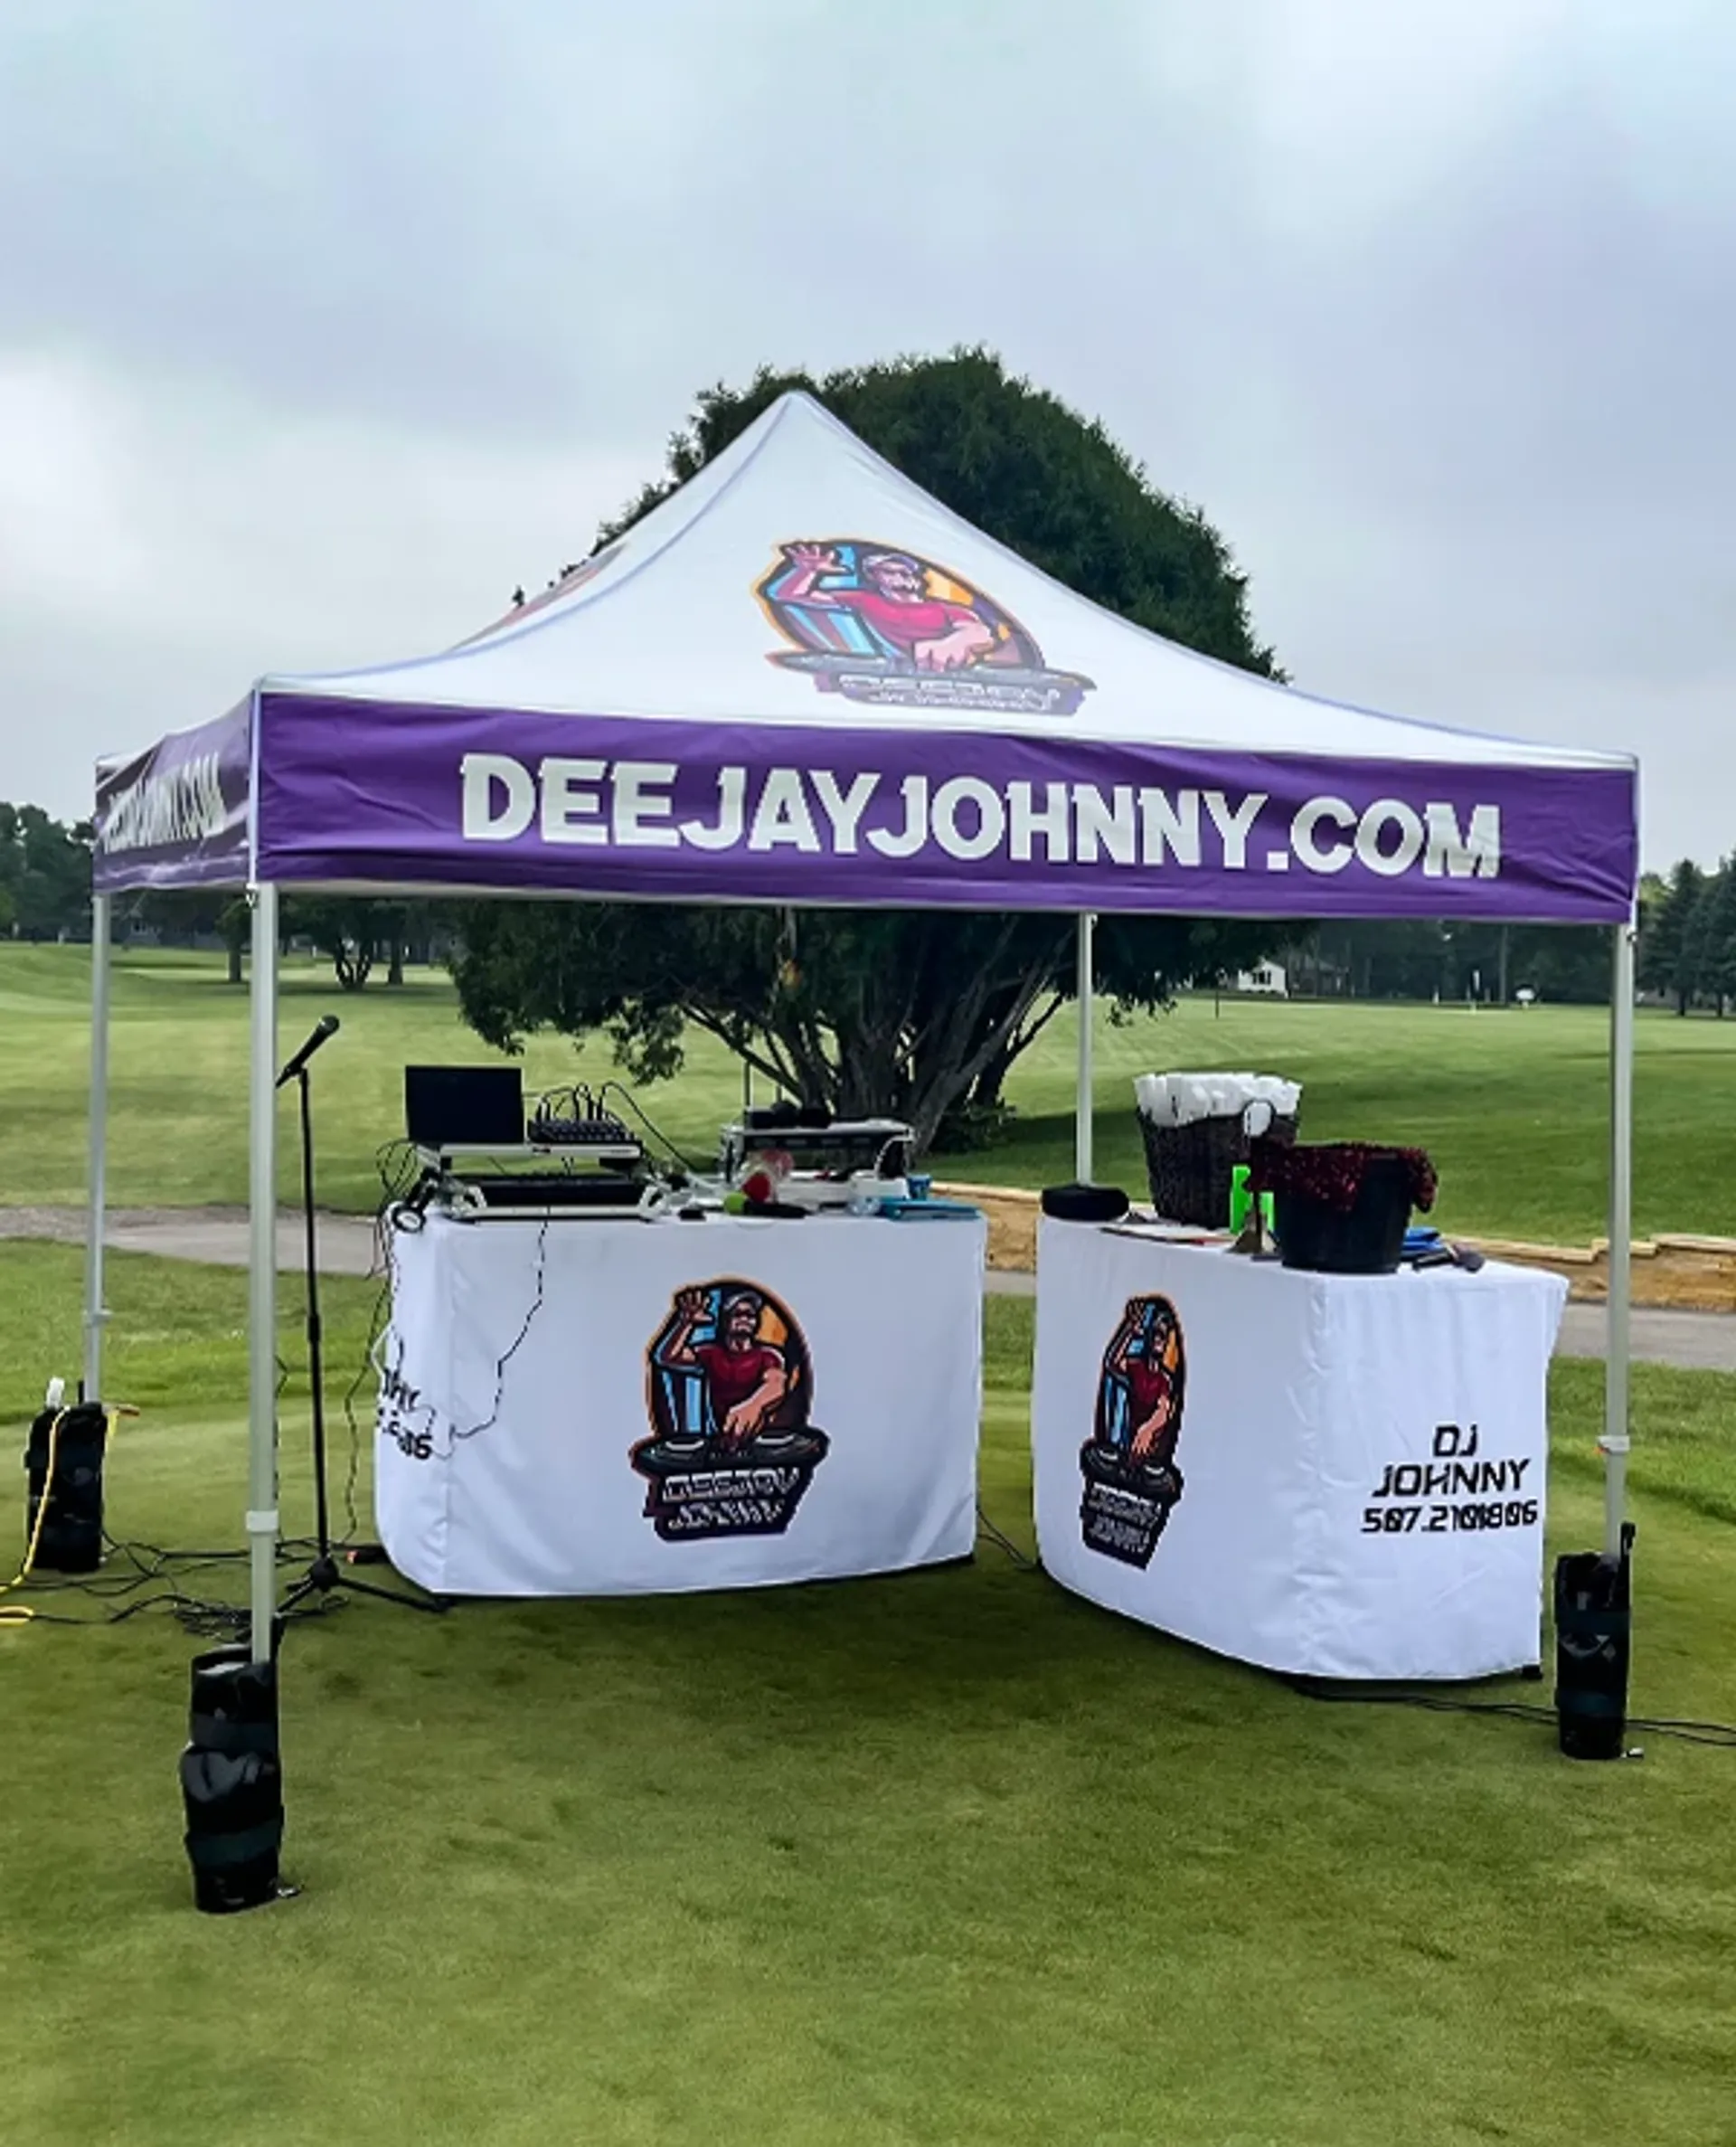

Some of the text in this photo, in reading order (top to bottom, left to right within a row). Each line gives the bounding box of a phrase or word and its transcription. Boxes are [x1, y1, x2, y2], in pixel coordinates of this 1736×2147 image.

[460, 752, 1501, 878] DEEJAYJOHNNY.COM
[1433, 1424, 1477, 1457] DJ
[1372, 1458, 1531, 1497] JOHNNY
